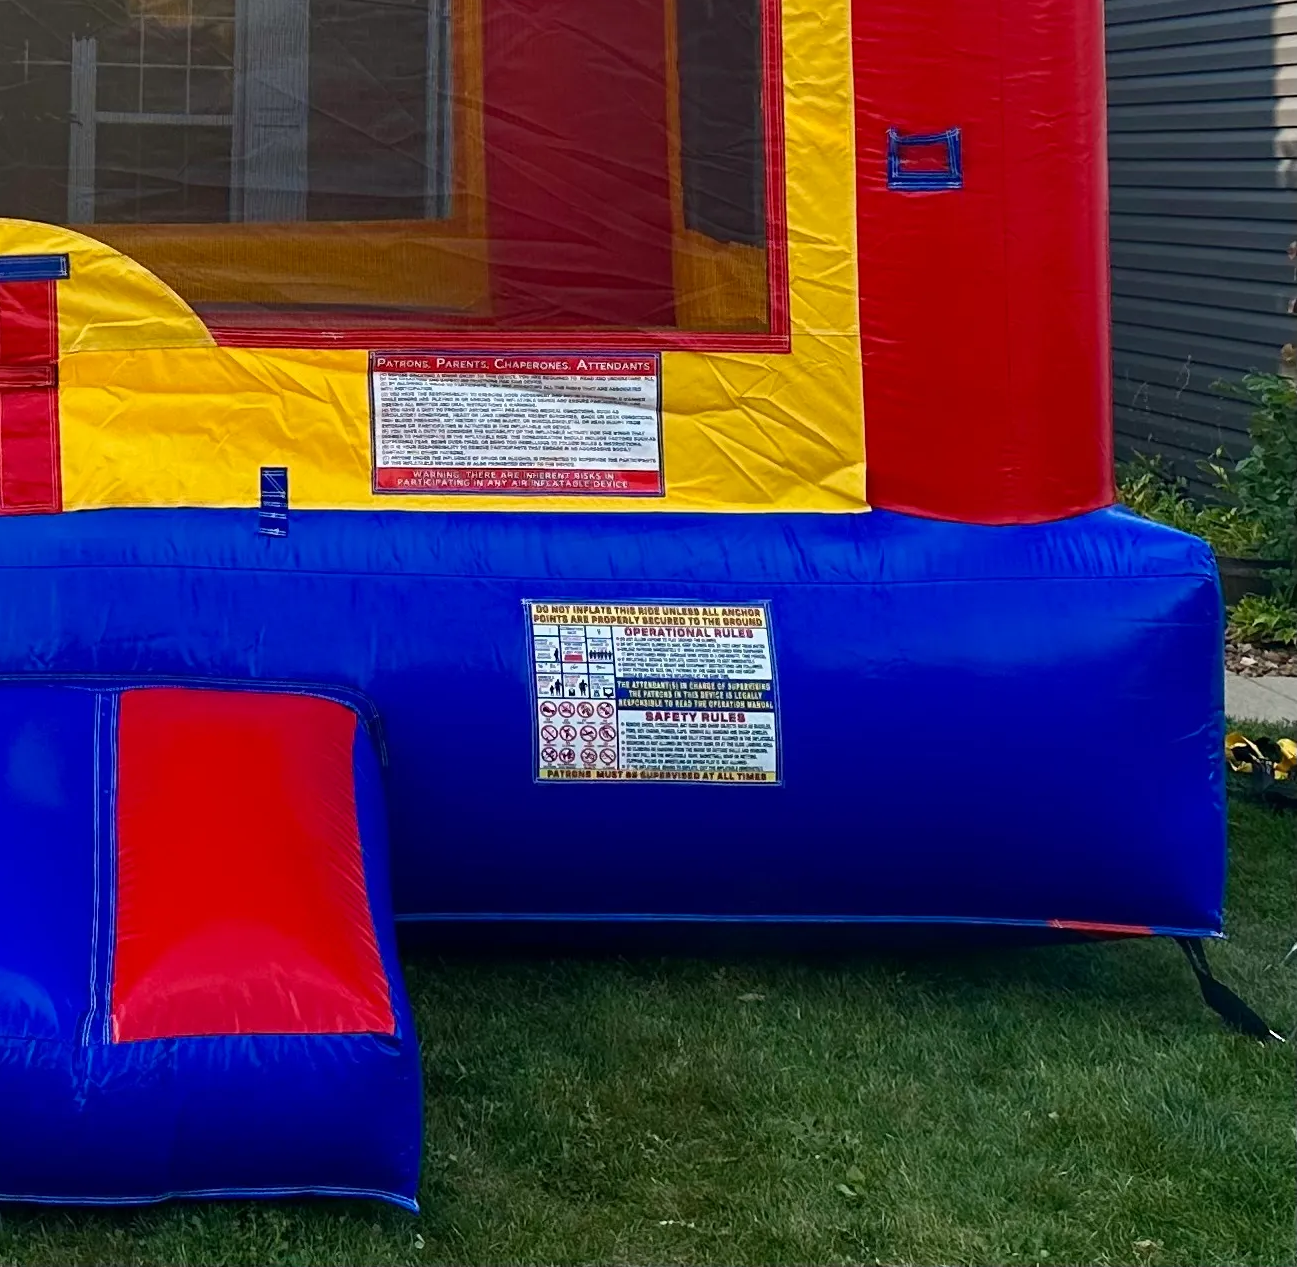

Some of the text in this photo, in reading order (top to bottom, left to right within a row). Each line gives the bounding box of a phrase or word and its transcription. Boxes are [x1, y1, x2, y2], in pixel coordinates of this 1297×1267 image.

[576, 359, 650, 371] ATTENDANTS
[466, 471, 496, 479] THERE
[500, 471, 520, 480] ARE
[604, 472, 614, 480] IN
[397, 478, 470, 487] PARTICIPATING
[473, 479, 484, 487] IN
[488, 479, 507, 488] ANY
[510, 479, 528, 488] AIR
[593, 480, 628, 489] DEVICE
[535, 605, 760, 617] DO NOT INFLATE THIS RIDE UNLESS ALL ANCHOR
[534, 614, 762, 626] POINTS ARE PROPERLY SECURED TO THE GROUND
[624, 628, 754, 639] OPERATIONAL RULES
[645, 711, 746, 723] SAFETY RULES
[547, 769, 767, 780] PATRONS MUST BE SUPERVISED AT ALL TIMES
